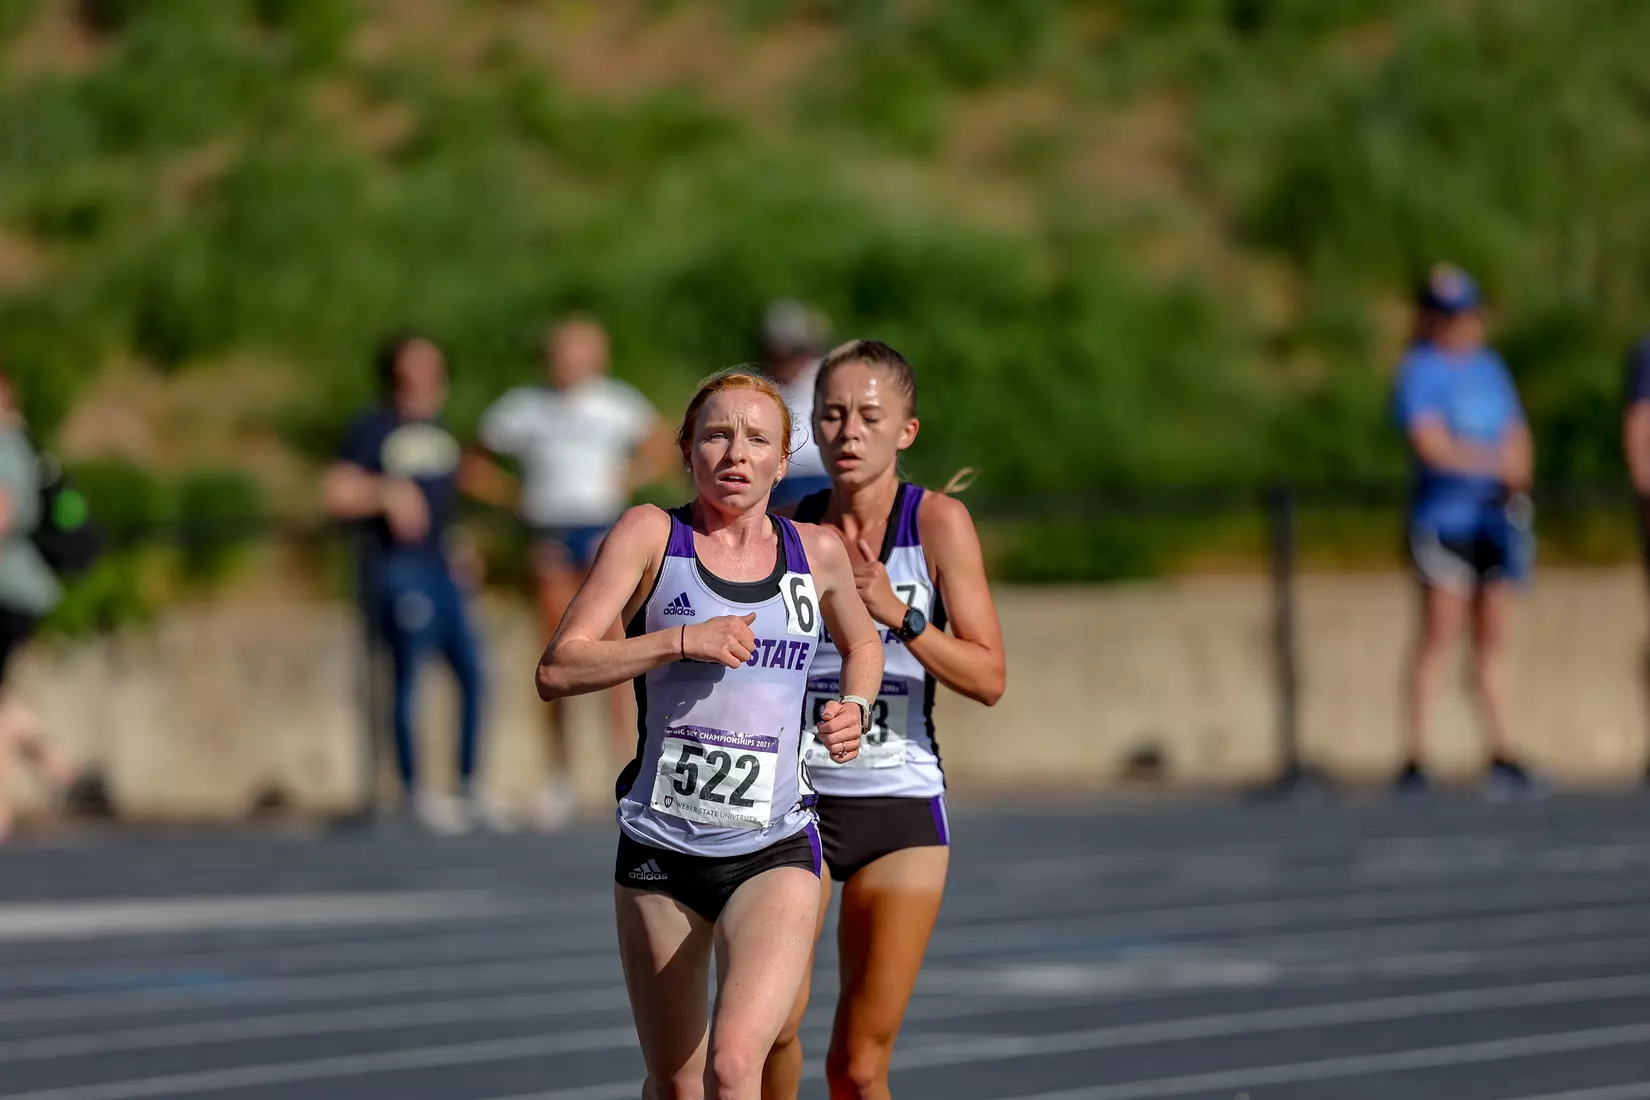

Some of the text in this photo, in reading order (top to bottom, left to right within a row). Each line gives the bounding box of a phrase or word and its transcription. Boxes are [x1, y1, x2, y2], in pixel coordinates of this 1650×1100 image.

[789, 577, 814, 633] 6
[896, 584, 917, 607] 7
[663, 606, 696, 616] adidas
[746, 638, 810, 671] STATE
[686, 729, 698, 737] SKY
[699, 732, 755, 746] CHAMPIONSHIPS
[673, 744, 760, 807] 522
[676, 802, 758, 822] WEBER STATE UNIVERSITY
[628, 871, 668, 880] adidas
